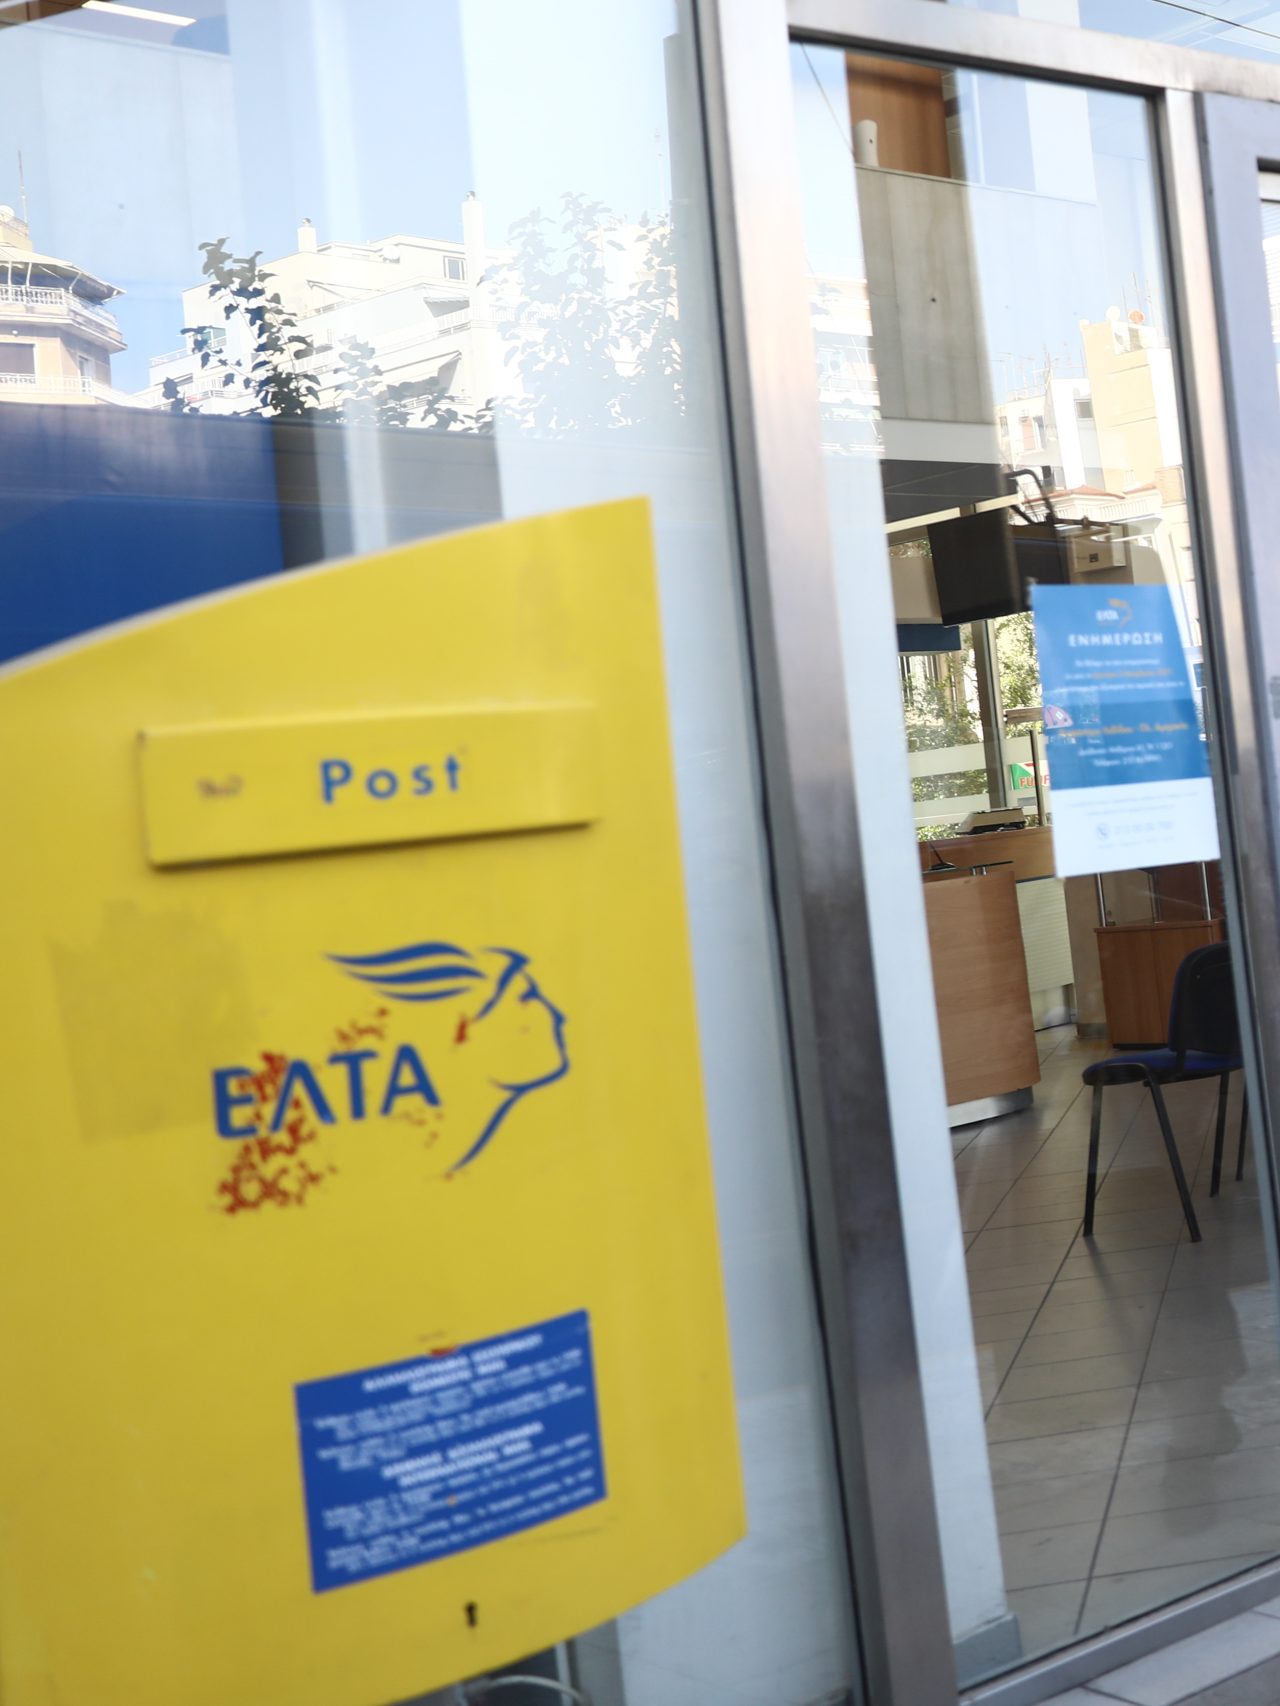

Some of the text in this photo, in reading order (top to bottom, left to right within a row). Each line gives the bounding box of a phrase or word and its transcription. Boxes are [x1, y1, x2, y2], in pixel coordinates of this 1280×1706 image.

[1068, 632, 1164, 647] ΕΝΗΜΕΡΩΣΗ
[320, 755, 459, 805] Post
[211, 1043, 441, 1140] ΕΛΤΑ
